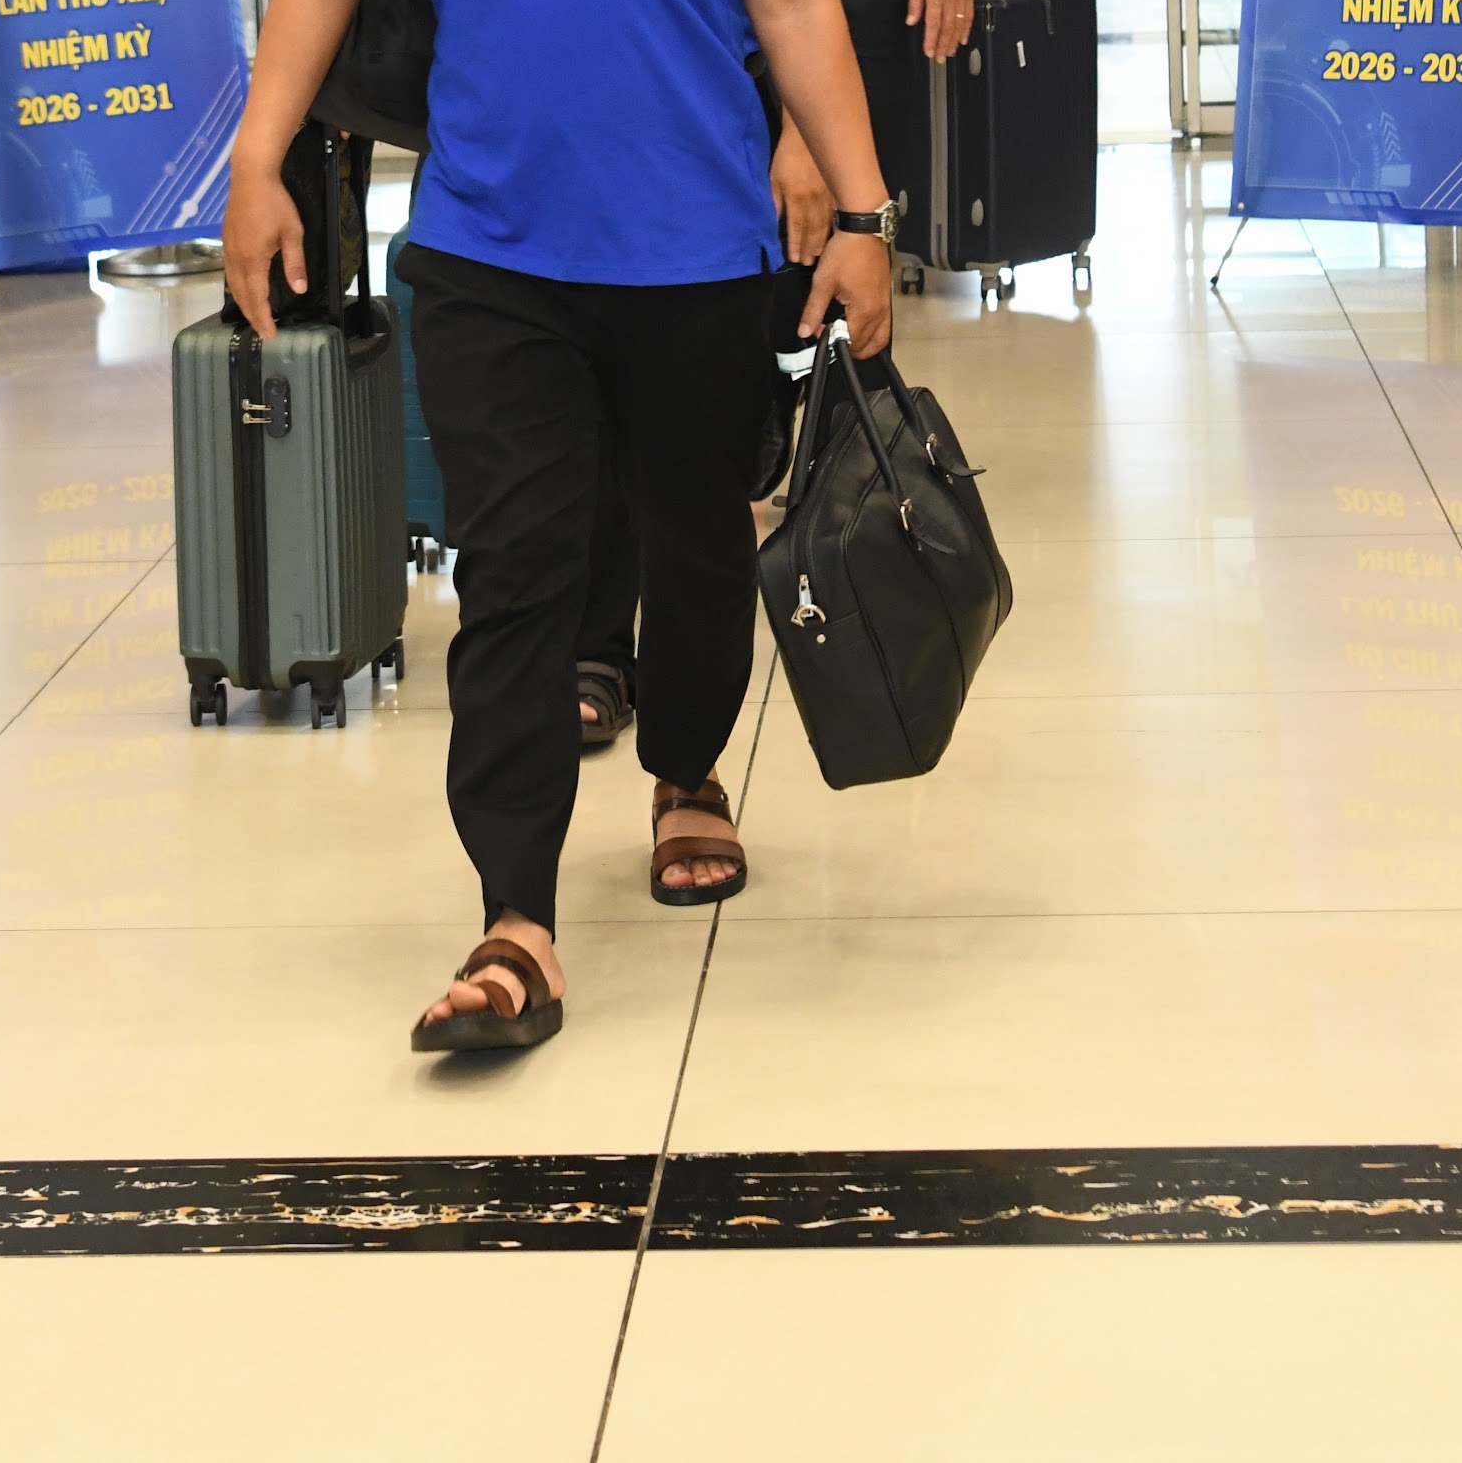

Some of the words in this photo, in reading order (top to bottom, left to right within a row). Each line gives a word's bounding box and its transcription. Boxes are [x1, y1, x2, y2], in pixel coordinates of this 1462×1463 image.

[21, 30, 109, 70] NHIỆM
[115, 22, 151, 59] KỲ
[1323, 51, 1395, 81] 2026
[18, 93, 81, 126] 2026
[88, 103, 99, 111] -
[105, 83, 173, 116] 2031
